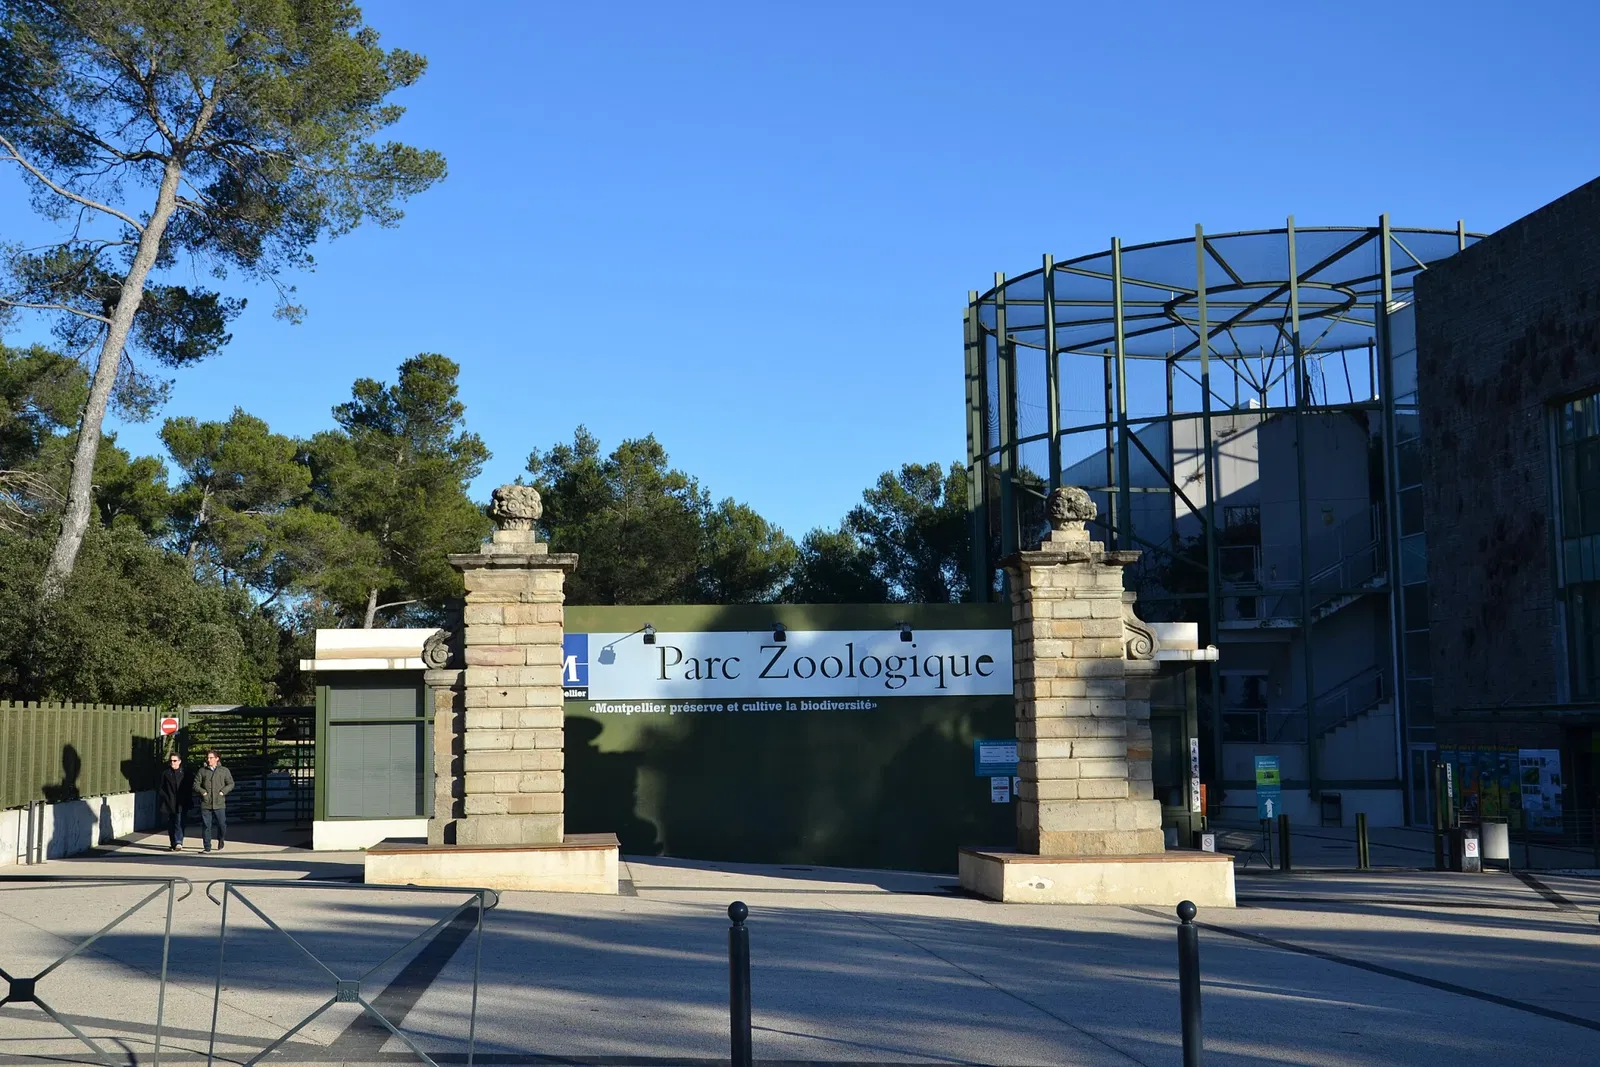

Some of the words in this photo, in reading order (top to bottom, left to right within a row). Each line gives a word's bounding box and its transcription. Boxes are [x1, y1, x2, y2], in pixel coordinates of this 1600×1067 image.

[656, 645, 741, 681] Parc
[758, 642, 995, 690] Zoologique
[564, 689, 586, 698] ellier
[670, 702, 723, 715] préserve
[727, 702, 740, 712] et
[742, 700, 783, 713] cultive
[785, 700, 798, 712] la
